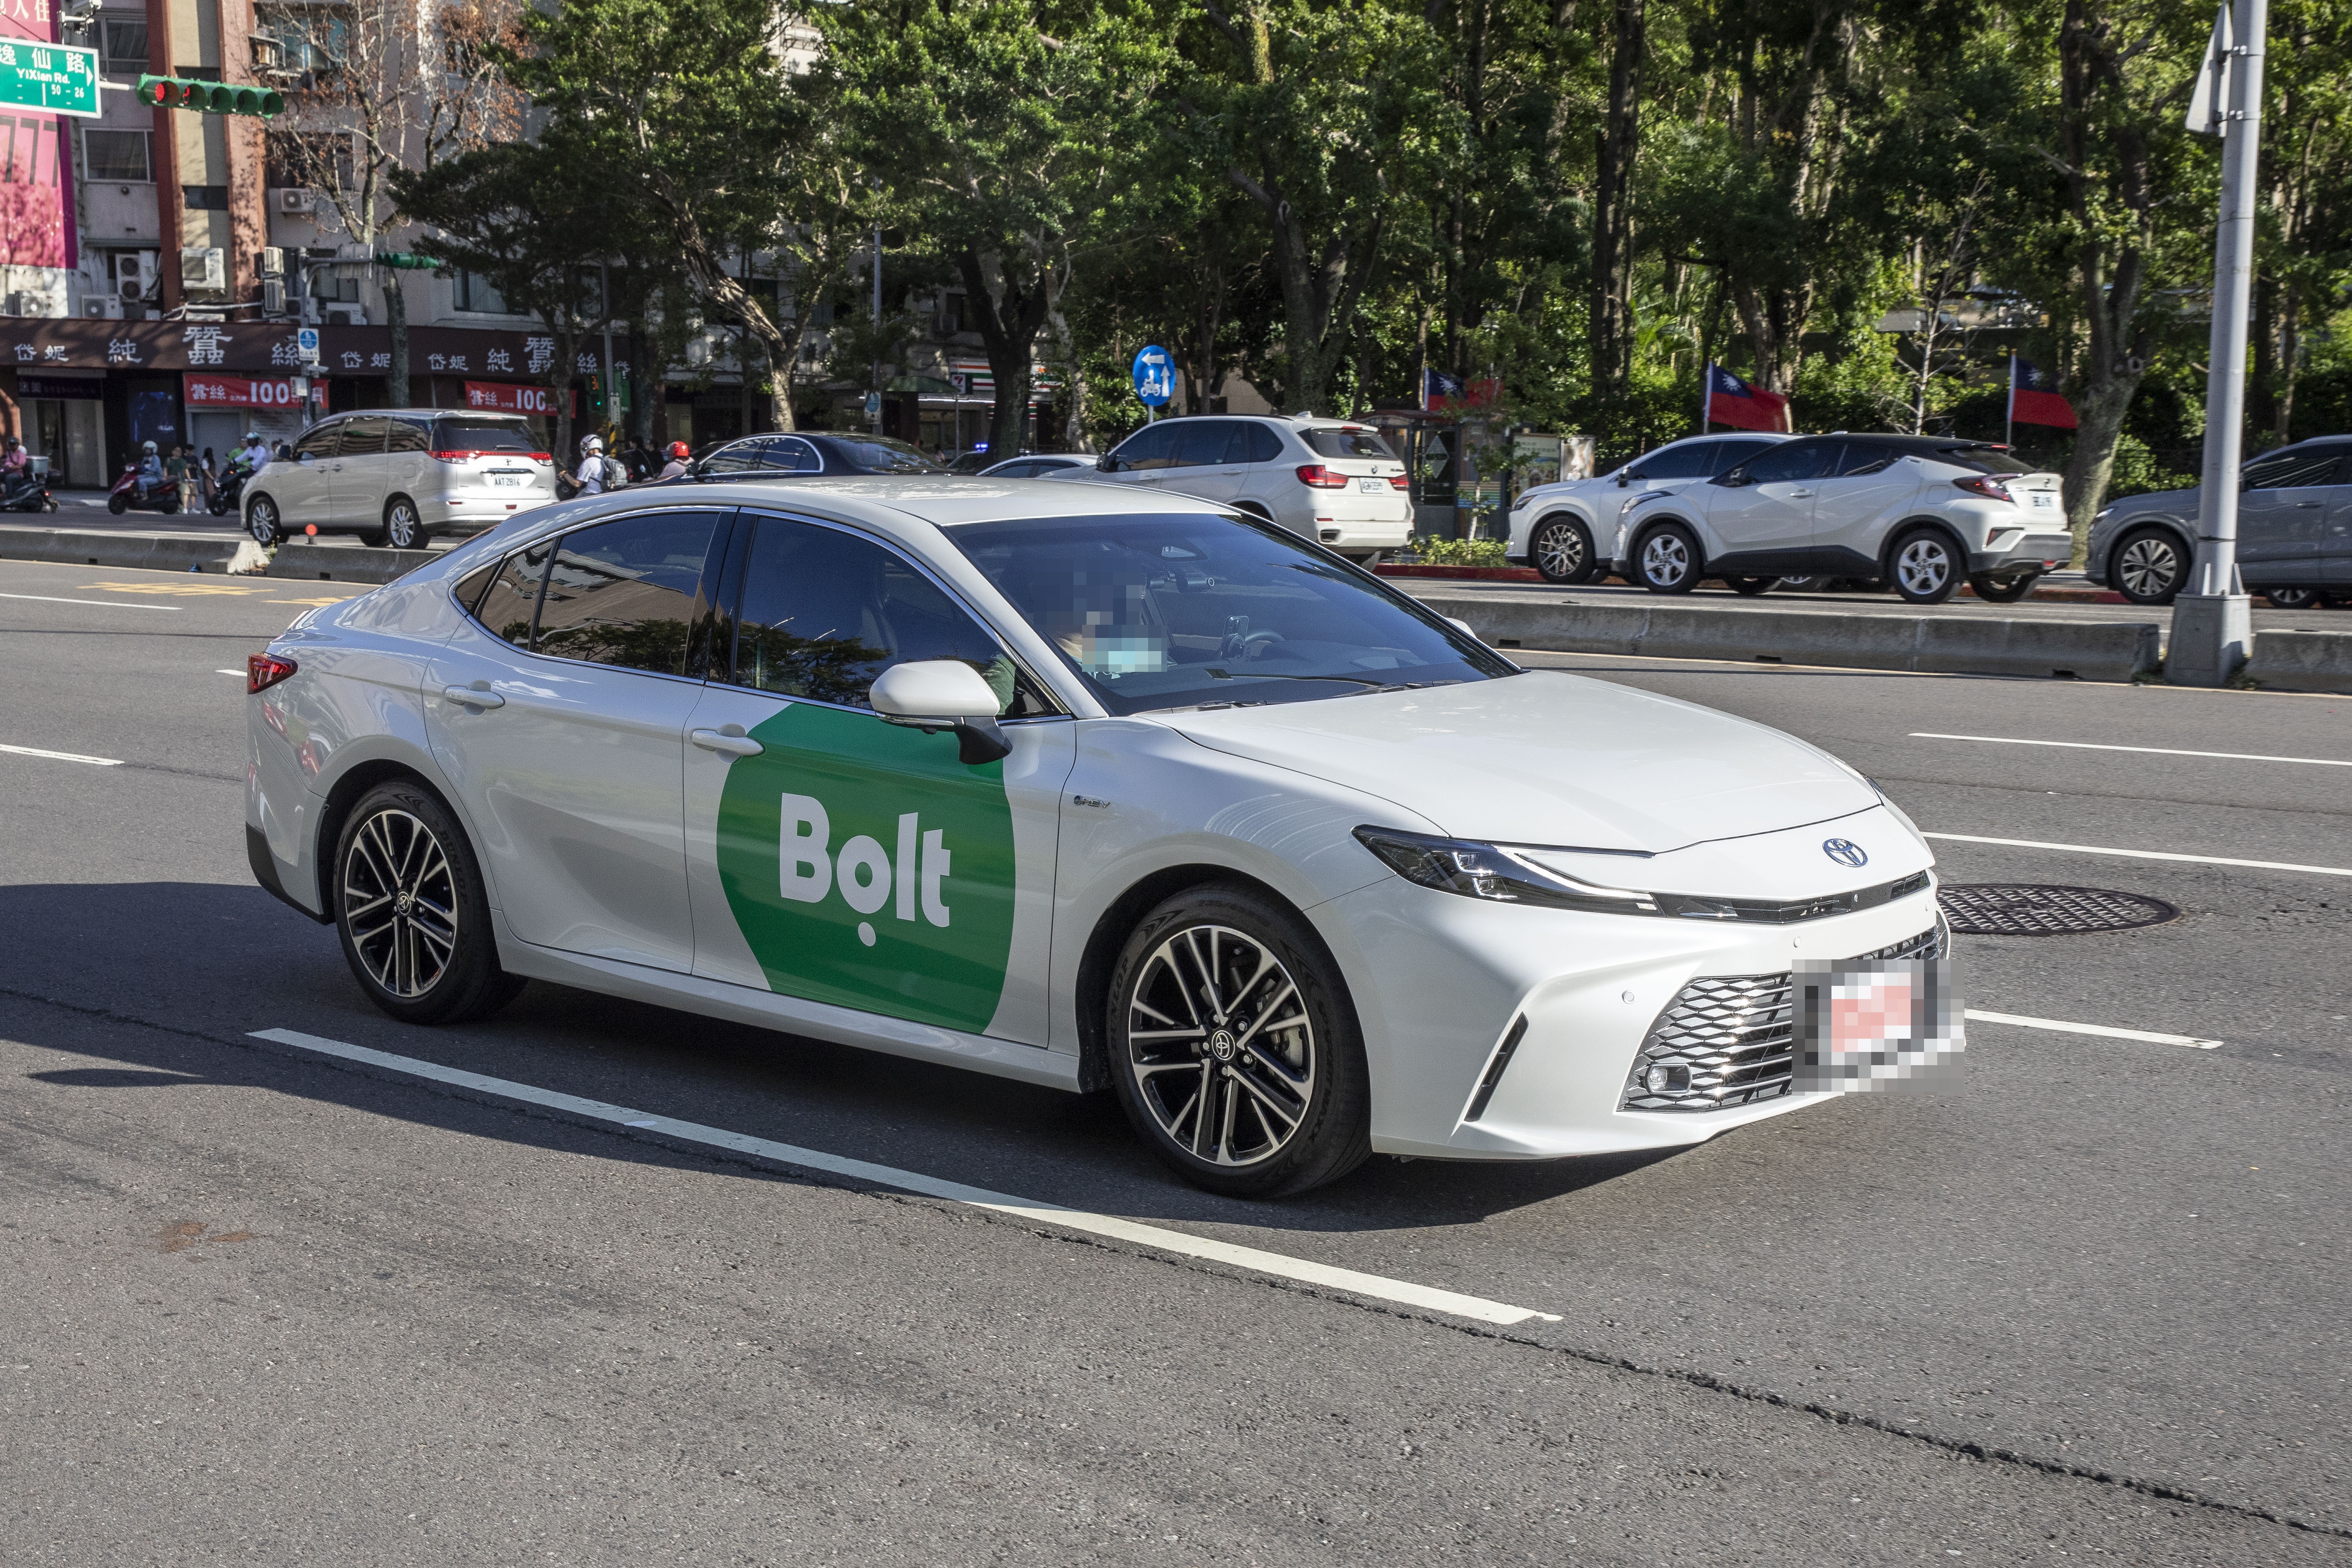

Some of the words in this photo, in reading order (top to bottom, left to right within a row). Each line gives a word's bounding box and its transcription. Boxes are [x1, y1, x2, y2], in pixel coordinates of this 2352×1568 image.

[16, 67, 52, 82] YiXian
[54, 72, 70, 84] Rd.
[51, 84, 61, 95] 50
[74, 87, 84, 98] 26
[779, 792, 951, 928] Bolt
